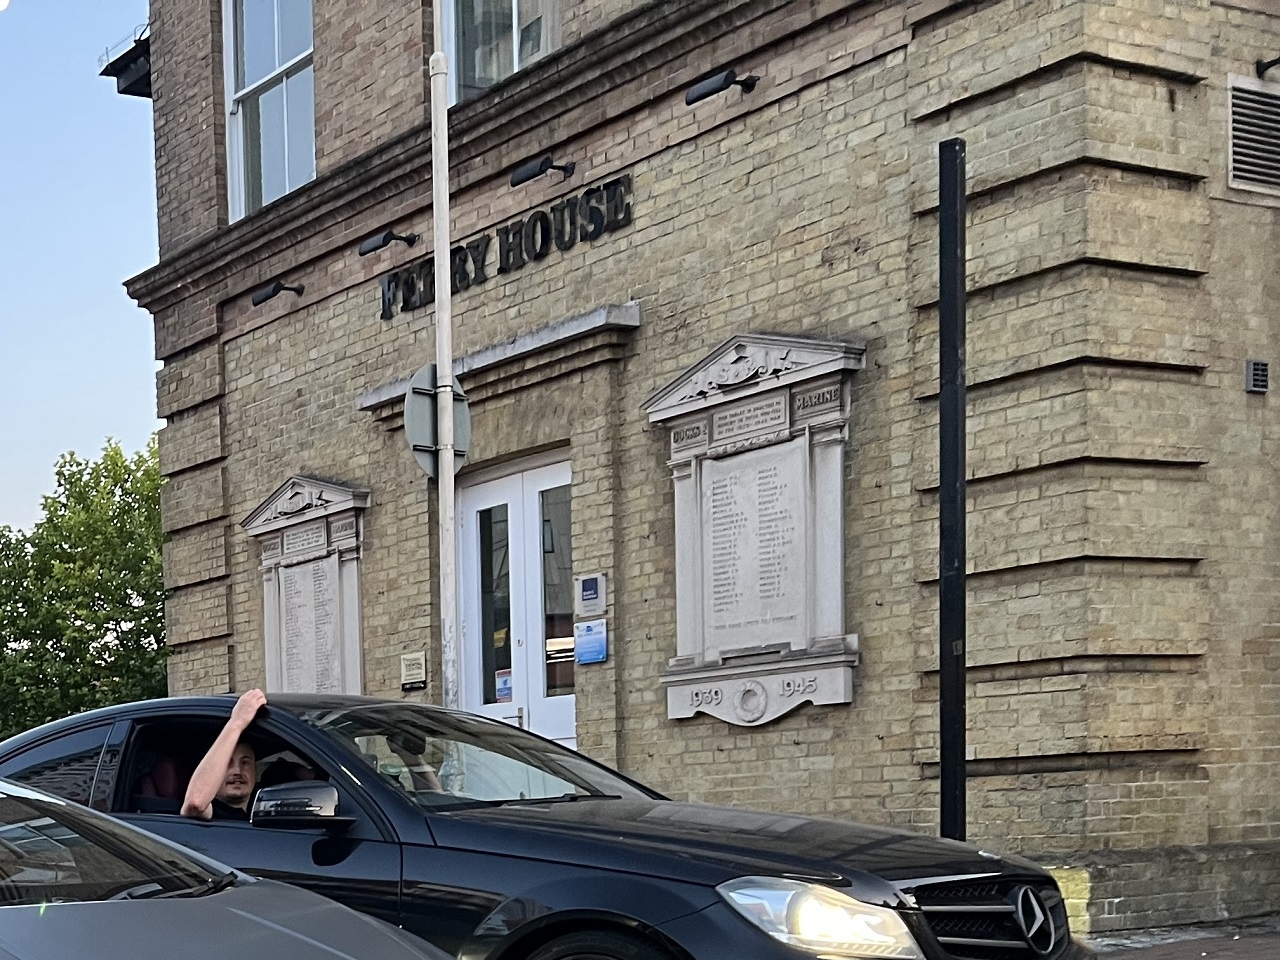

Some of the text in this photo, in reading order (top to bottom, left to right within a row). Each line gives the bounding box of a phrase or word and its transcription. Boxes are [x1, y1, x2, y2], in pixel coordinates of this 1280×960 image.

[379, 173, 634, 320] FERRY HOUSE
[795, 387, 840, 411] MARINE
[689, 676, 818, 707] 1939 1945
